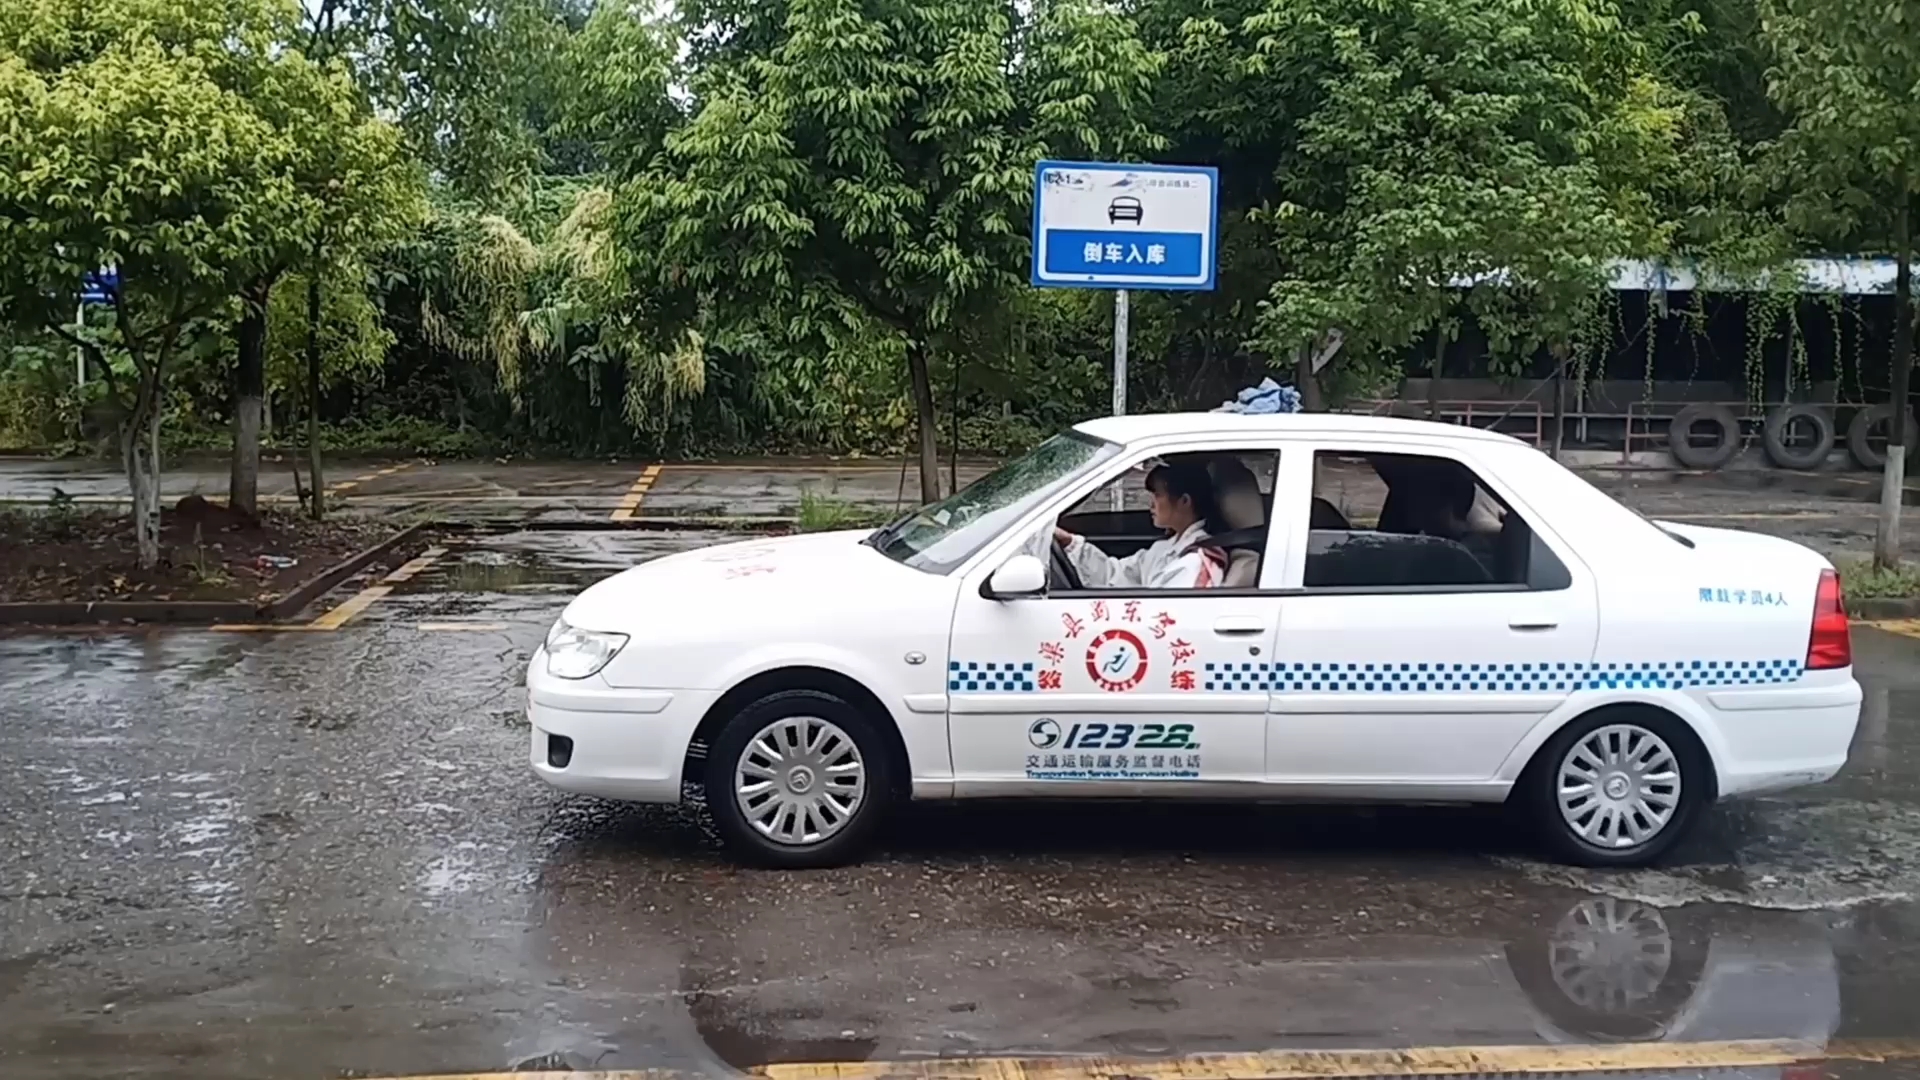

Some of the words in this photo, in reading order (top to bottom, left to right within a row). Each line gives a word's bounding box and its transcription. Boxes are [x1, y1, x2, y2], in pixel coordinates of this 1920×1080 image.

[1083, 241, 1167, 265] 倒车入库
[1063, 723, 1196, 749] 12328
[1025, 754, 1202, 769] 交通运输服务监督电话
[1088, 769, 1119, 778] Service
[1120, 769, 1169, 778] Supervision
